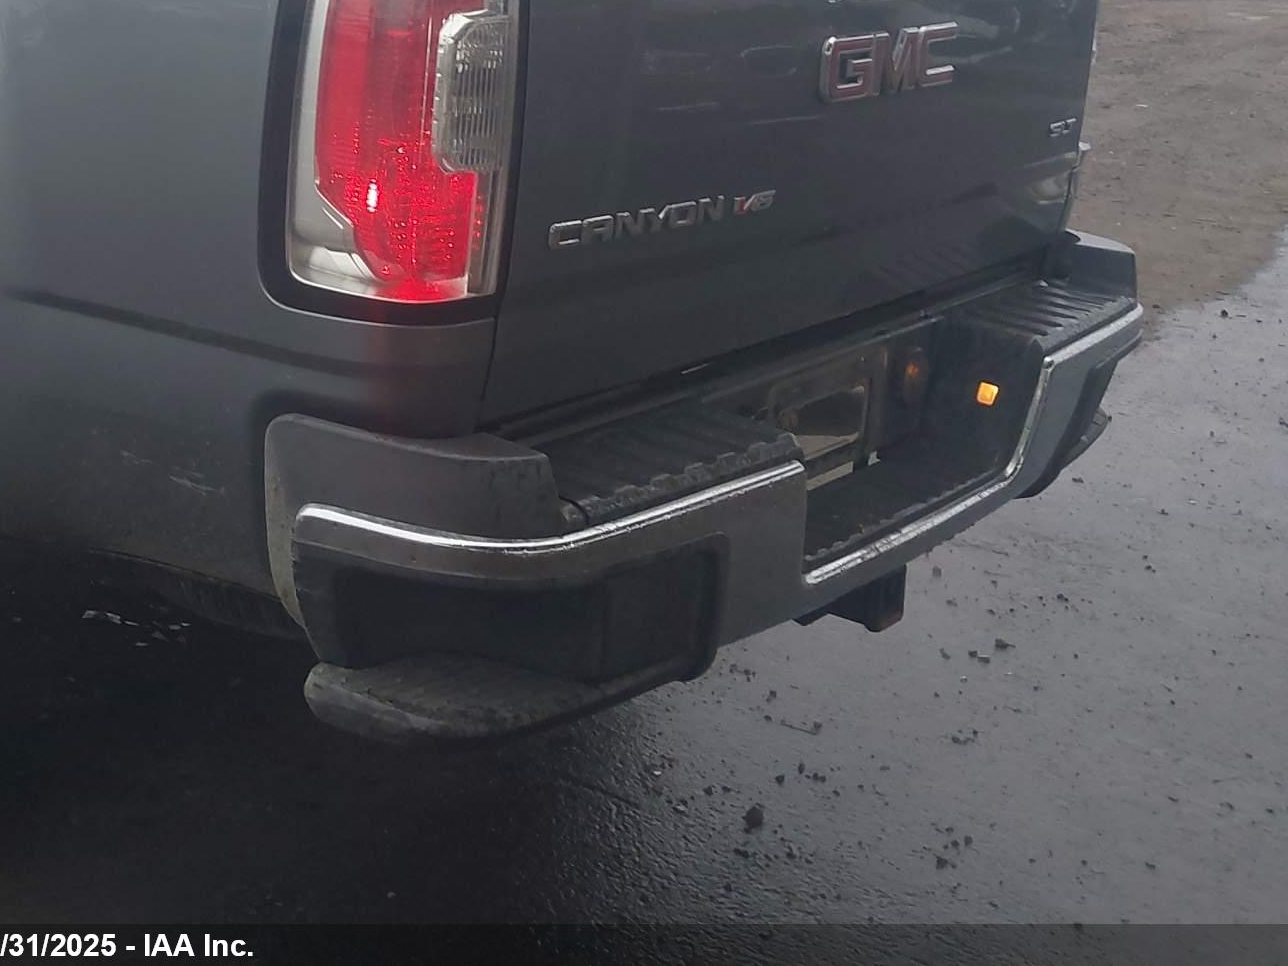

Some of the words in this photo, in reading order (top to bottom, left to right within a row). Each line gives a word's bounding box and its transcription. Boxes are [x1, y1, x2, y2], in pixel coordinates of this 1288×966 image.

[820, 21, 958, 103] GMC
[548, 195, 725, 250] CANYON
[733, 190, 776, 214] V6
